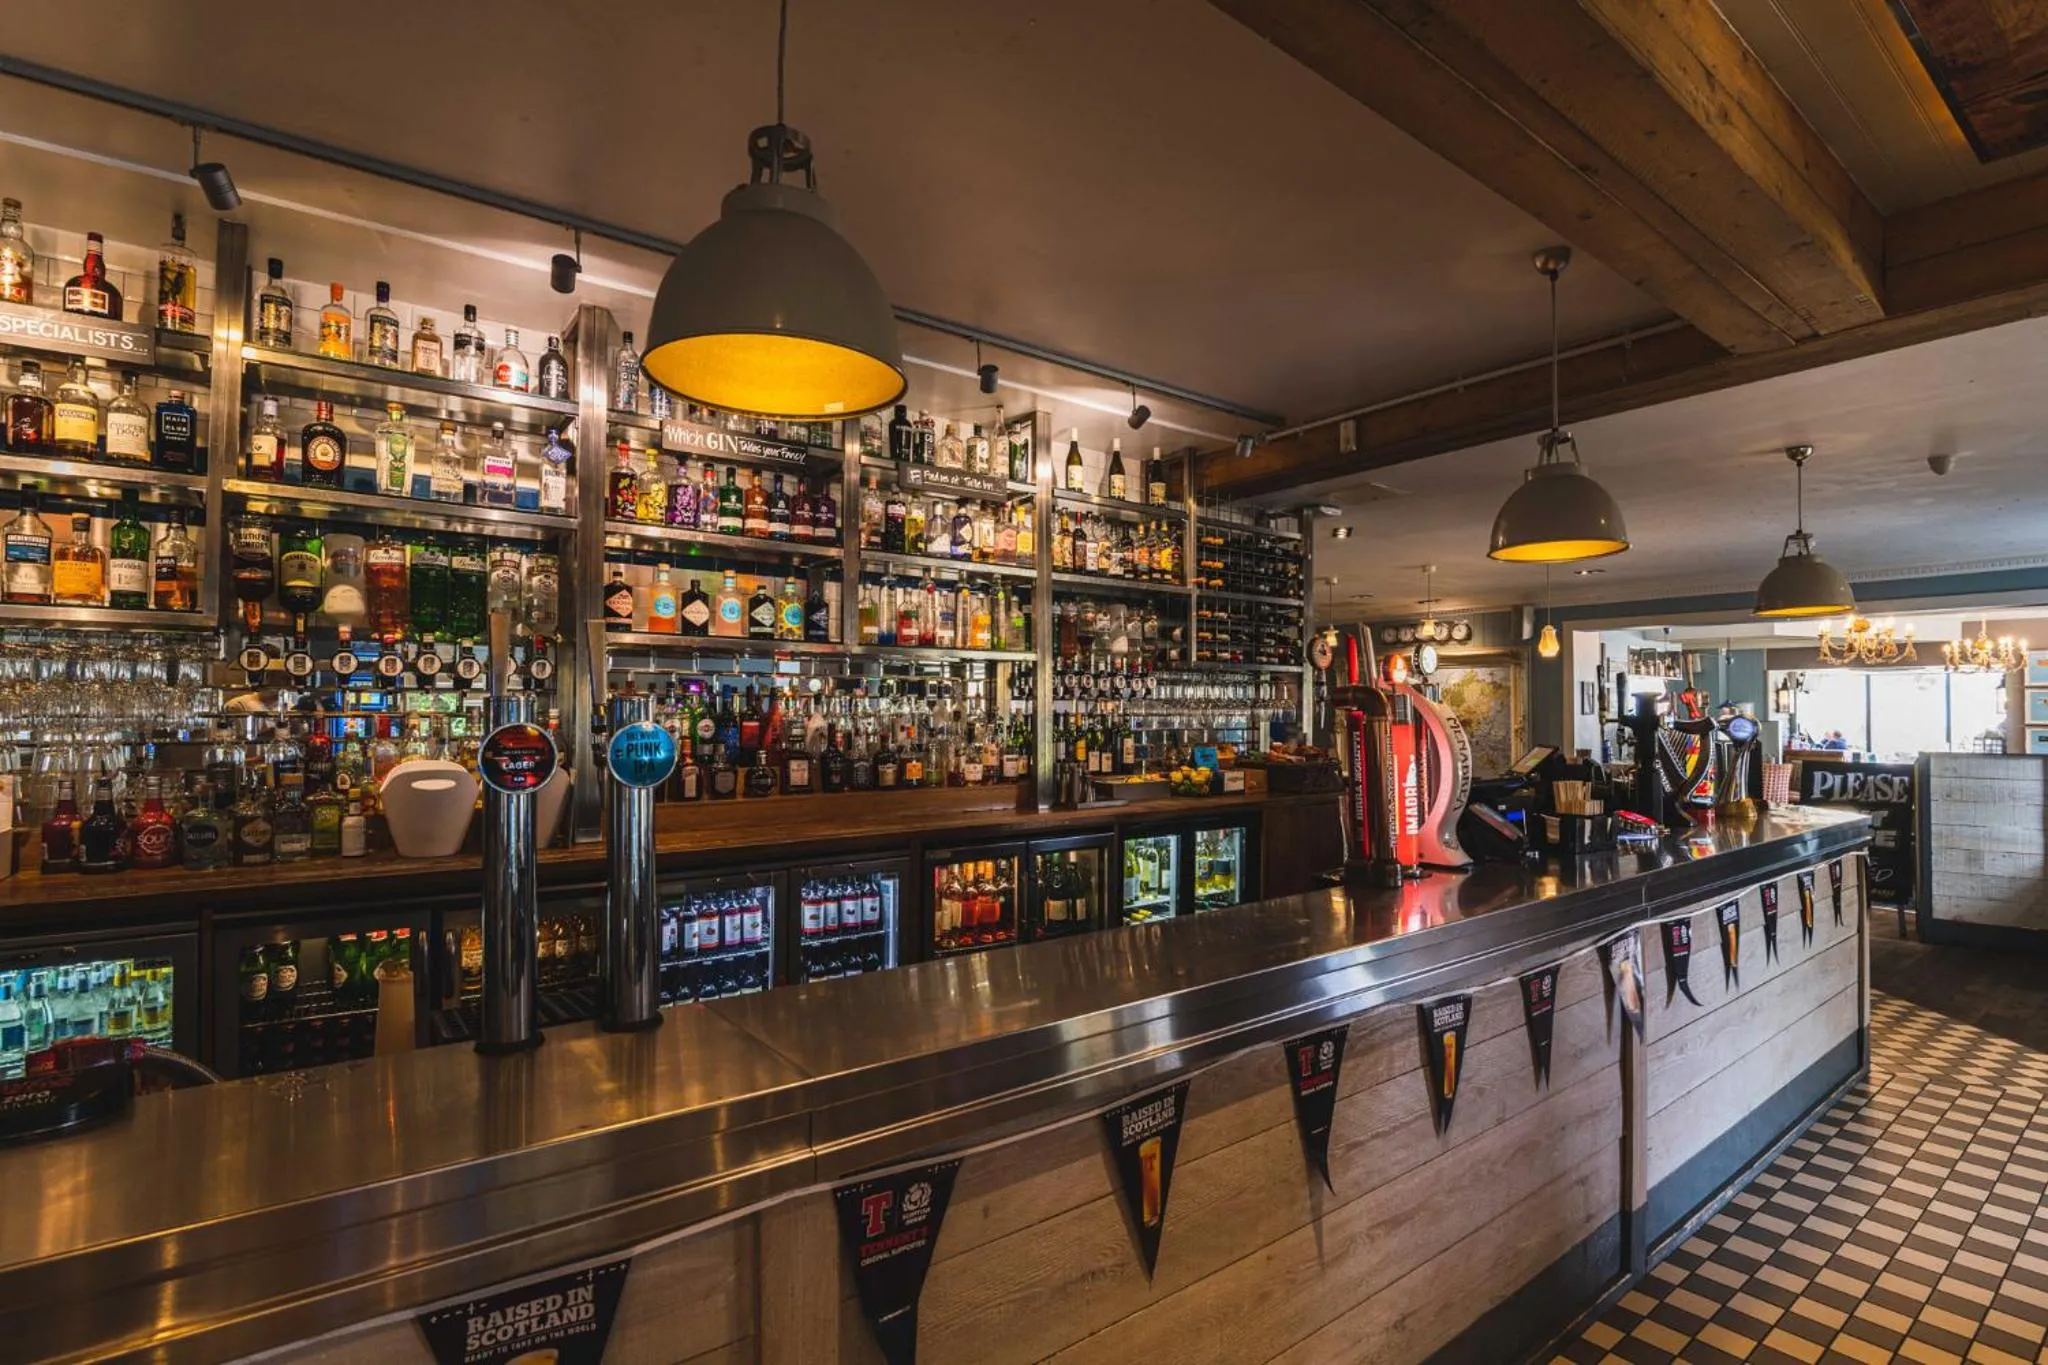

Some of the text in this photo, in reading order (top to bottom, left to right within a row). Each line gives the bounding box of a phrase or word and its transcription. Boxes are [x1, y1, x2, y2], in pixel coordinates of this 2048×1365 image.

[706, 432, 739, 455] GIN
[502, 761, 536, 770] LAGER
[626, 742, 662, 758] PUNK
[1446, 716, 1471, 813] MENABREA
[1810, 770, 1909, 803] PLEASE
[1122, 1095, 1176, 1128] RAISED IN
[1122, 1106, 1176, 1139] SCOTLAND
[862, 1190, 893, 1237] T
[467, 1284, 595, 1334] RAISED IN
[466, 1303, 596, 1351] SCOTLAND
[464, 1349, 494, 1363] READY
